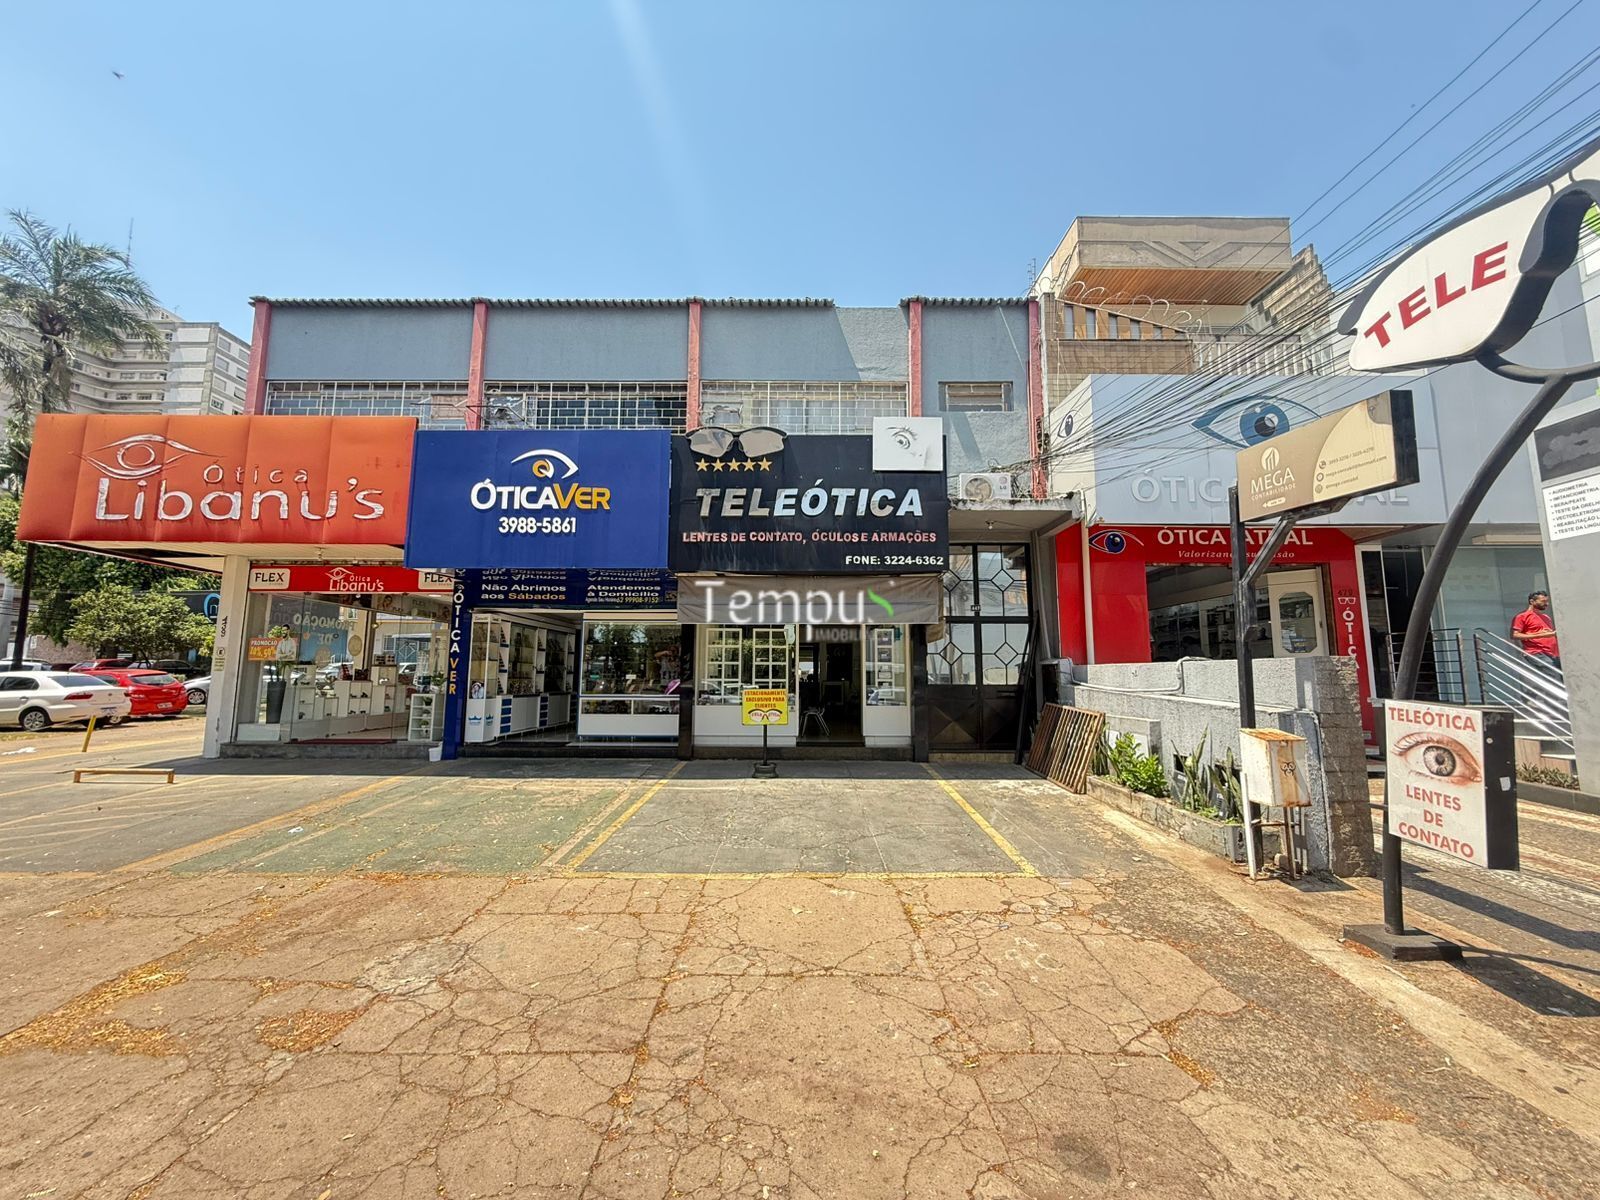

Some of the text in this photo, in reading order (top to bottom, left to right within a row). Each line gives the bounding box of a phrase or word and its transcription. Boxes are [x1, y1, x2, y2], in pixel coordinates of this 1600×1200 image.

[1363, 241, 1509, 349] TELE
[203, 460, 308, 484] Ótica
[1250, 467, 1296, 495] MEGA
[1131, 469, 1230, 504] ÓTIC
[1251, 482, 1297, 501] CONTABILIDADE
[1553, 483, 1588, 495] AUDIOMETRIA
[95, 477, 385, 522] Libanu's
[695, 478, 924, 517] TELEÓTICA
[1555, 506, 1571, 514] TESTE
[498, 517, 577, 534] 3988-5861
[682, 532, 728, 543] LENTES
[731, 532, 746, 543] DE
[750, 531, 807, 545] CONTATO,
[811, 528, 860, 543] ÓCULOS
[871, 530, 937, 545] ARMAÇÕES
[1157, 526, 1314, 546] ÓTICA ATAL
[845, 555, 944, 566] FONE: 3224-6362
[255, 572, 285, 583] FLEX
[329, 579, 385, 592] Libanu's
[350, 573, 371, 582] Ótica
[481, 583, 567, 592] Não Abrimos
[508, 592, 567, 600] Sábados
[448, 589, 465, 695] ÓTICA VER
[1388, 707, 1477, 733] TELEÓTICA
[1406, 784, 1463, 812] LENTES
[1423, 809, 1444, 828] DE
[1398, 822, 1475, 859] CONTATO
